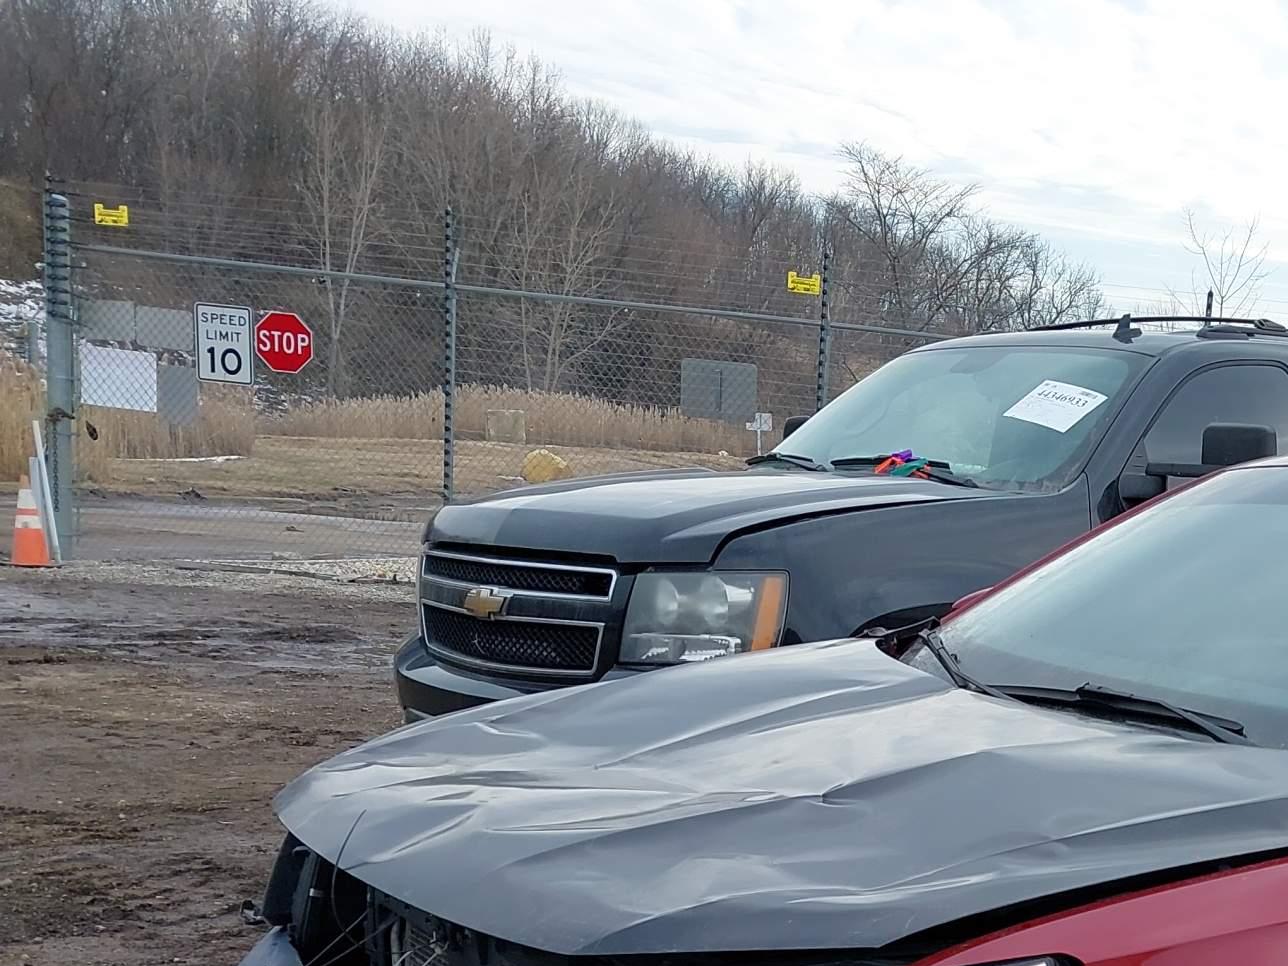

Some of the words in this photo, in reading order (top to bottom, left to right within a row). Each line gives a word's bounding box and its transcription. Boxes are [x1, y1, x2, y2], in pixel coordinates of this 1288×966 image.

[201, 312, 247, 327] SPEED
[206, 329, 242, 343] LIMIT
[259, 330, 309, 355] STOP
[206, 346, 242, 375] 10
